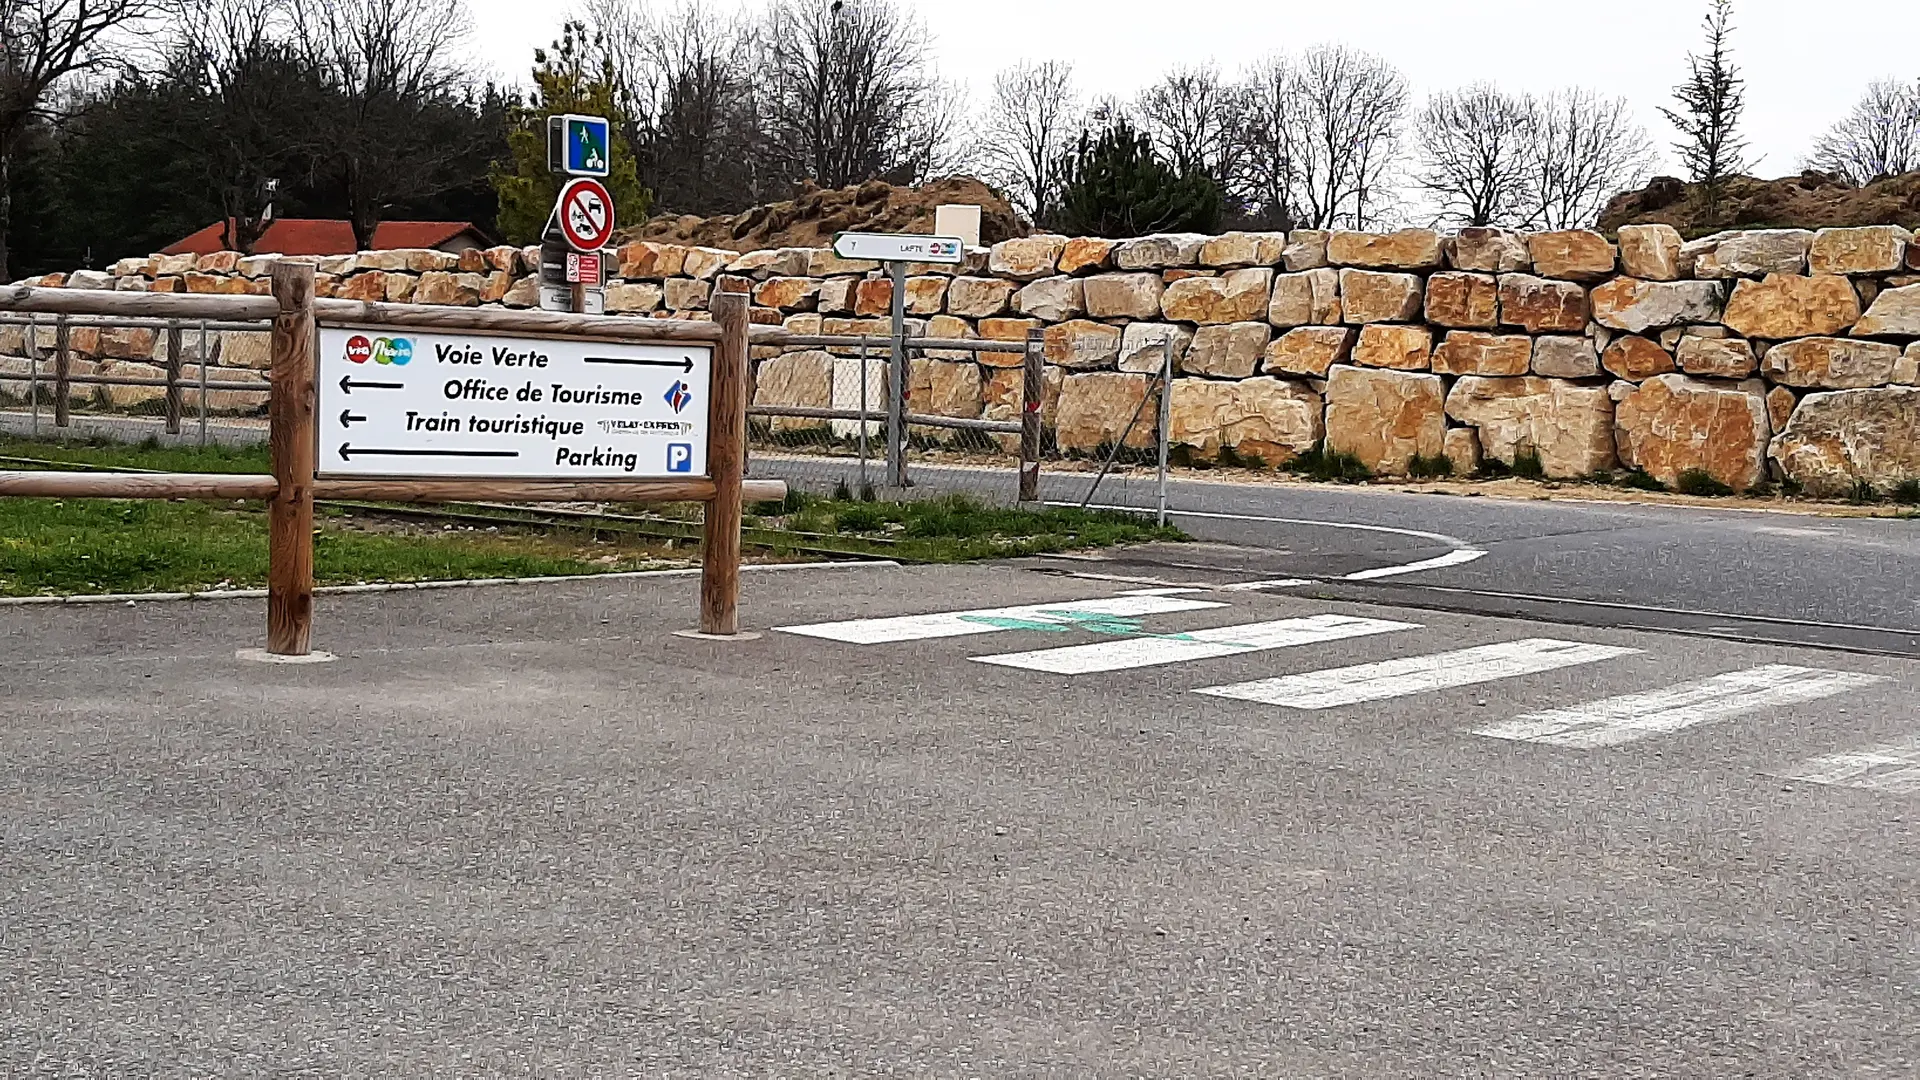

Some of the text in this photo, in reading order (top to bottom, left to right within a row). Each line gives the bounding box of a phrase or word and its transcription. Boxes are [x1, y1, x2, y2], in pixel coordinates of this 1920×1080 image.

[436, 344, 548, 368] Voie Verte
[444, 379, 642, 406] Office de Tourisme
[405, 412, 583, 440] Train touristique
[556, 447, 637, 472] Parking
[671, 447, 688, 469] P
